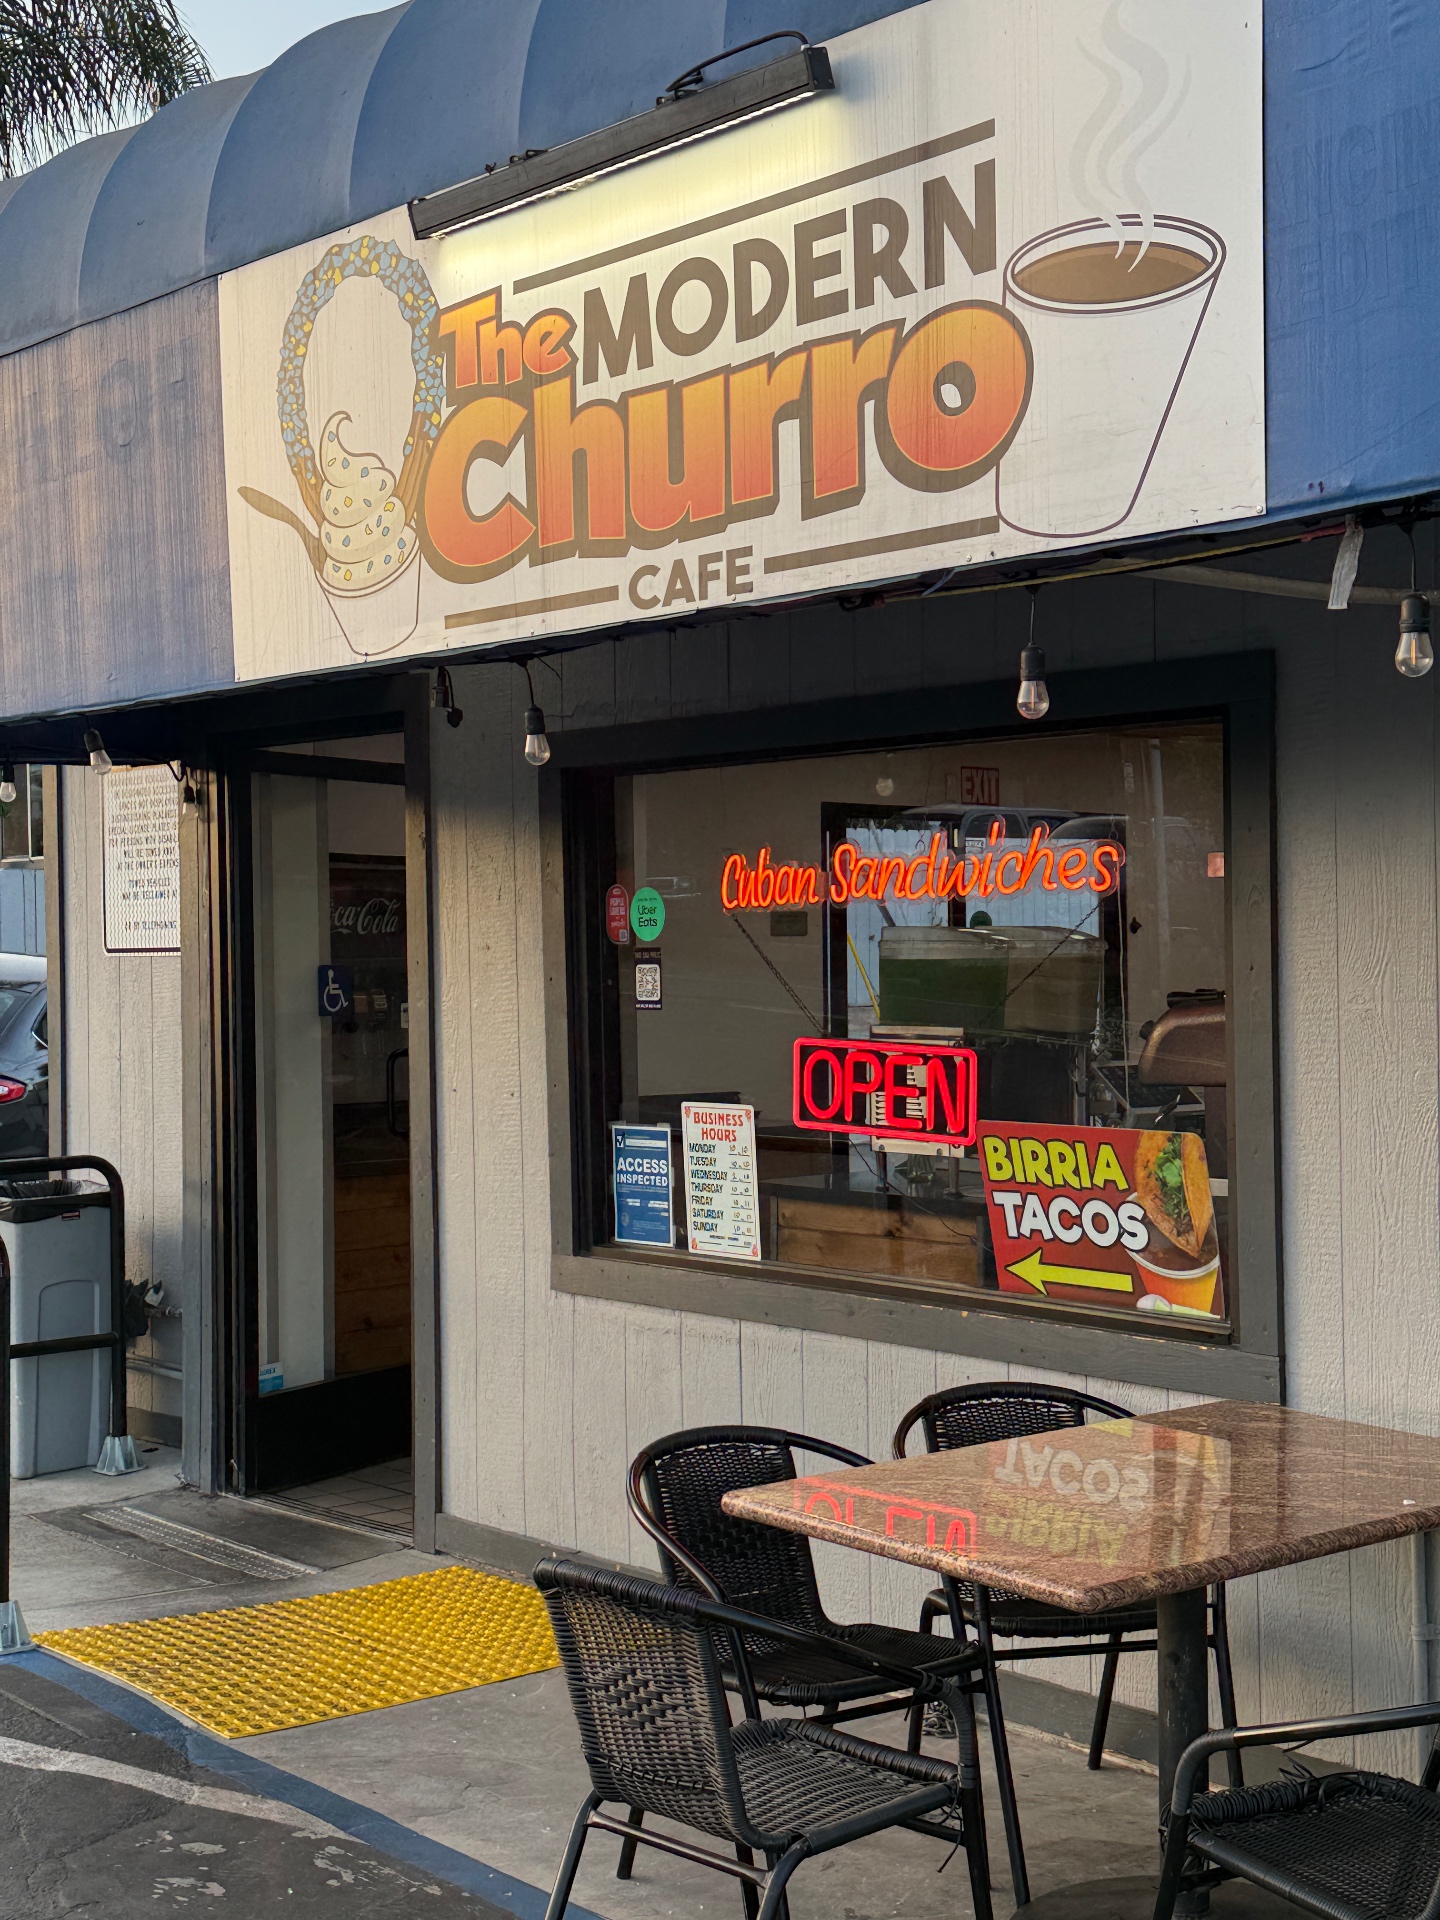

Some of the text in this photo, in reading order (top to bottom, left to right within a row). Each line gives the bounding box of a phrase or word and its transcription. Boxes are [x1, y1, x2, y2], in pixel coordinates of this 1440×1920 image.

[439, 158, 996, 391] The MODERN
[418, 300, 1034, 584] Churro
[628, 546, 754, 610] CAFE
[962, 768, 999, 805] EXIT
[160, 858, 178, 868] EXPENS
[721, 820, 1120, 908] Cuban Sandwiches
[637, 904, 658, 916] Uber
[638, 916, 658, 928] Eats
[803, 1049, 967, 1133] OPEN
[693, 1112, 744, 1127] BUSINESS
[702, 1127, 737, 1143] HOURS
[689, 1143, 716, 1153] MONDAY
[617, 1157, 668, 1174] ACCESS
[690, 1156, 716, 1167] TUESDAY
[982, 1135, 1130, 1192] BIRRIA
[617, 1173, 668, 1187] INSPECTED
[691, 1169, 727, 1181] WEDNESDAY
[691, 1182, 723, 1194] THURSDAY
[692, 1195, 713, 1206] FRIDAY
[692, 1208, 724, 1220] SATURDAY
[992, 1190, 1150, 1252] TACOS
[693, 1221, 718, 1232] SUNDAY
